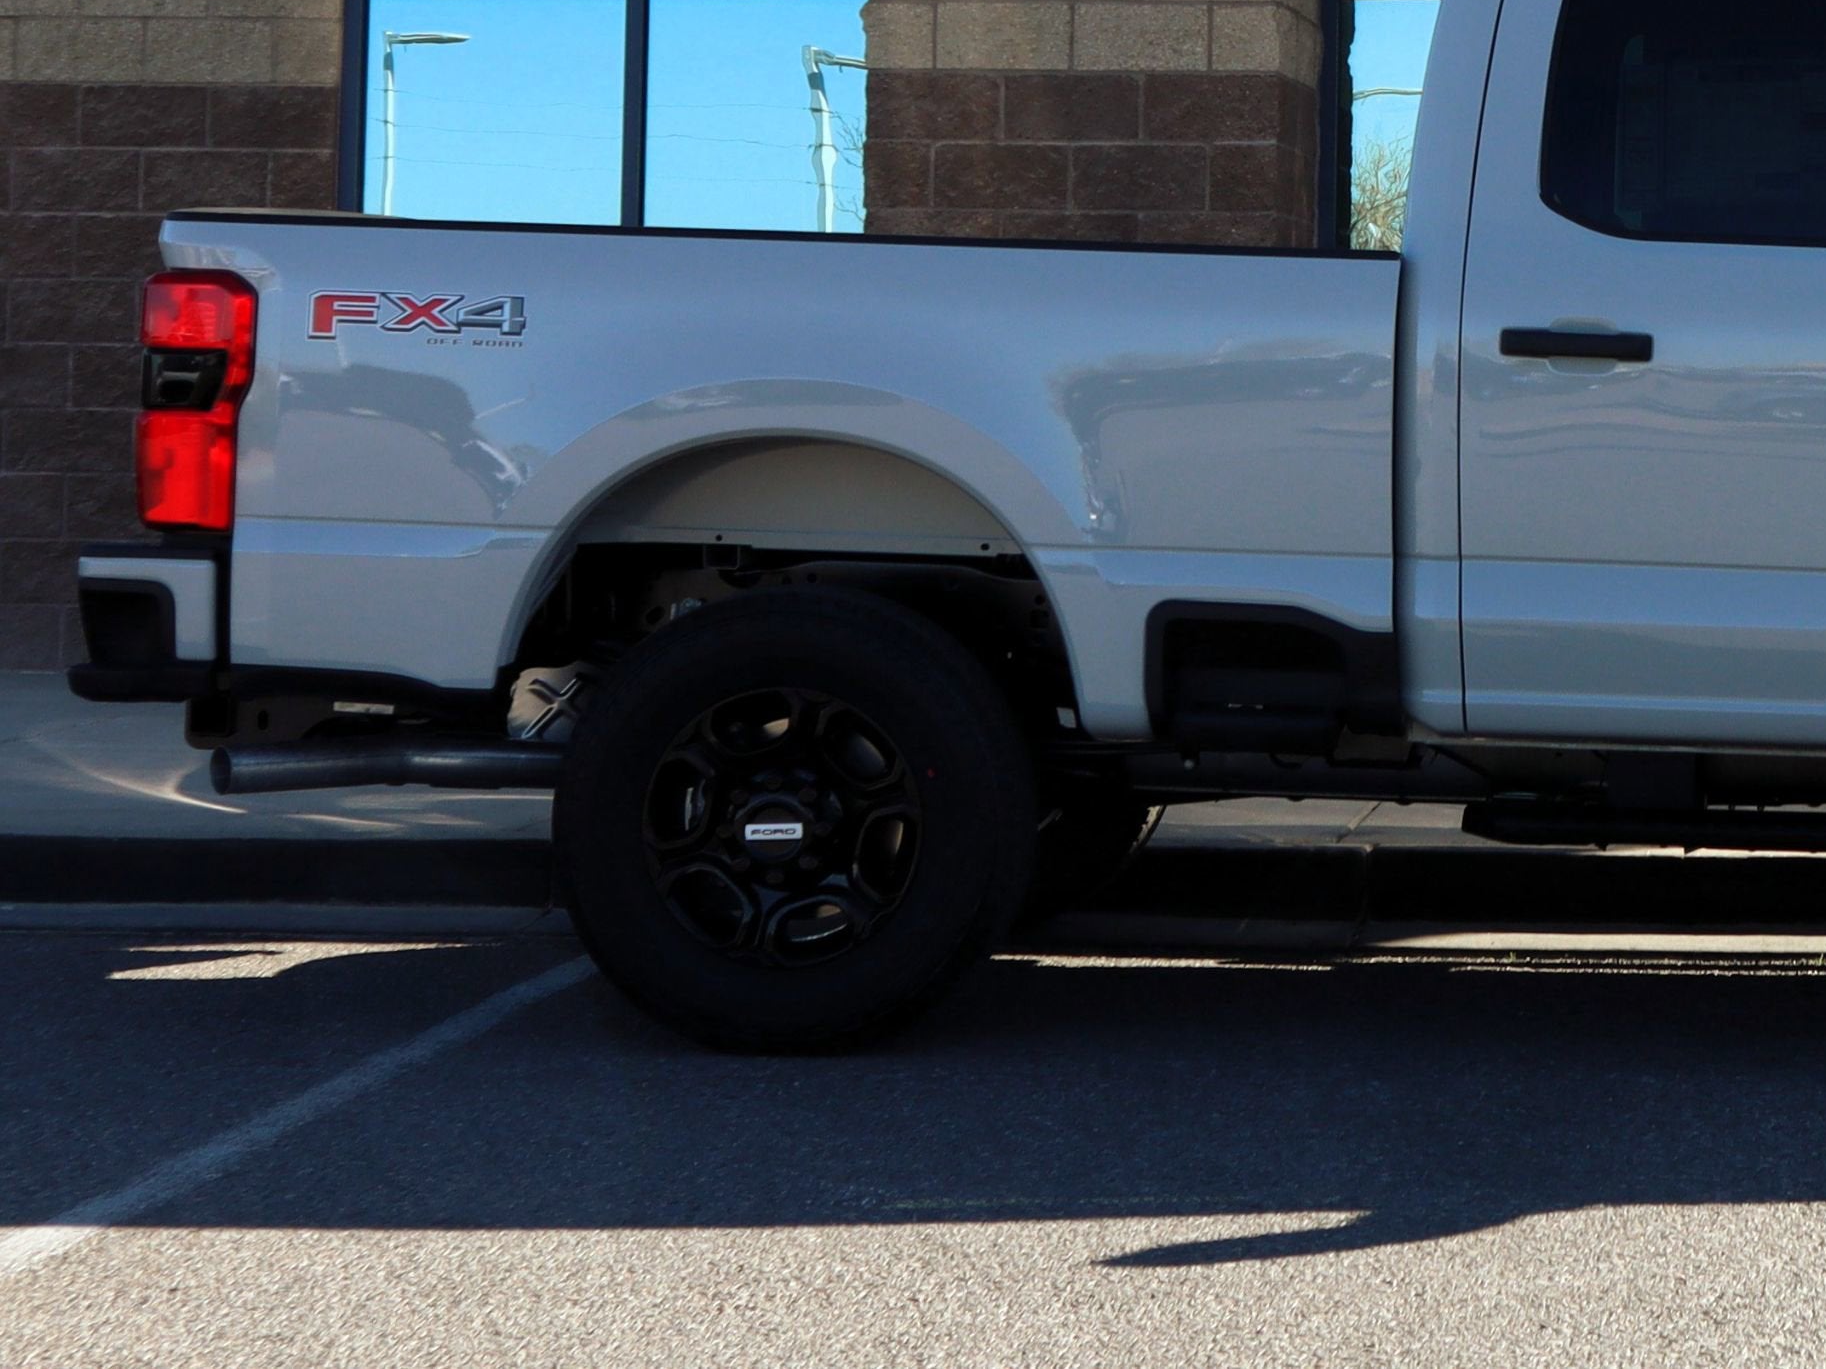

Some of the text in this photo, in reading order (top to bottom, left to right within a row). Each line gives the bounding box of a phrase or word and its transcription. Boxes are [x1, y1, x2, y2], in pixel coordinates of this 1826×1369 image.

[307, 290, 527, 340] FX4
[426, 338, 524, 348] OFF ROAD
[751, 828, 797, 836] FORD
